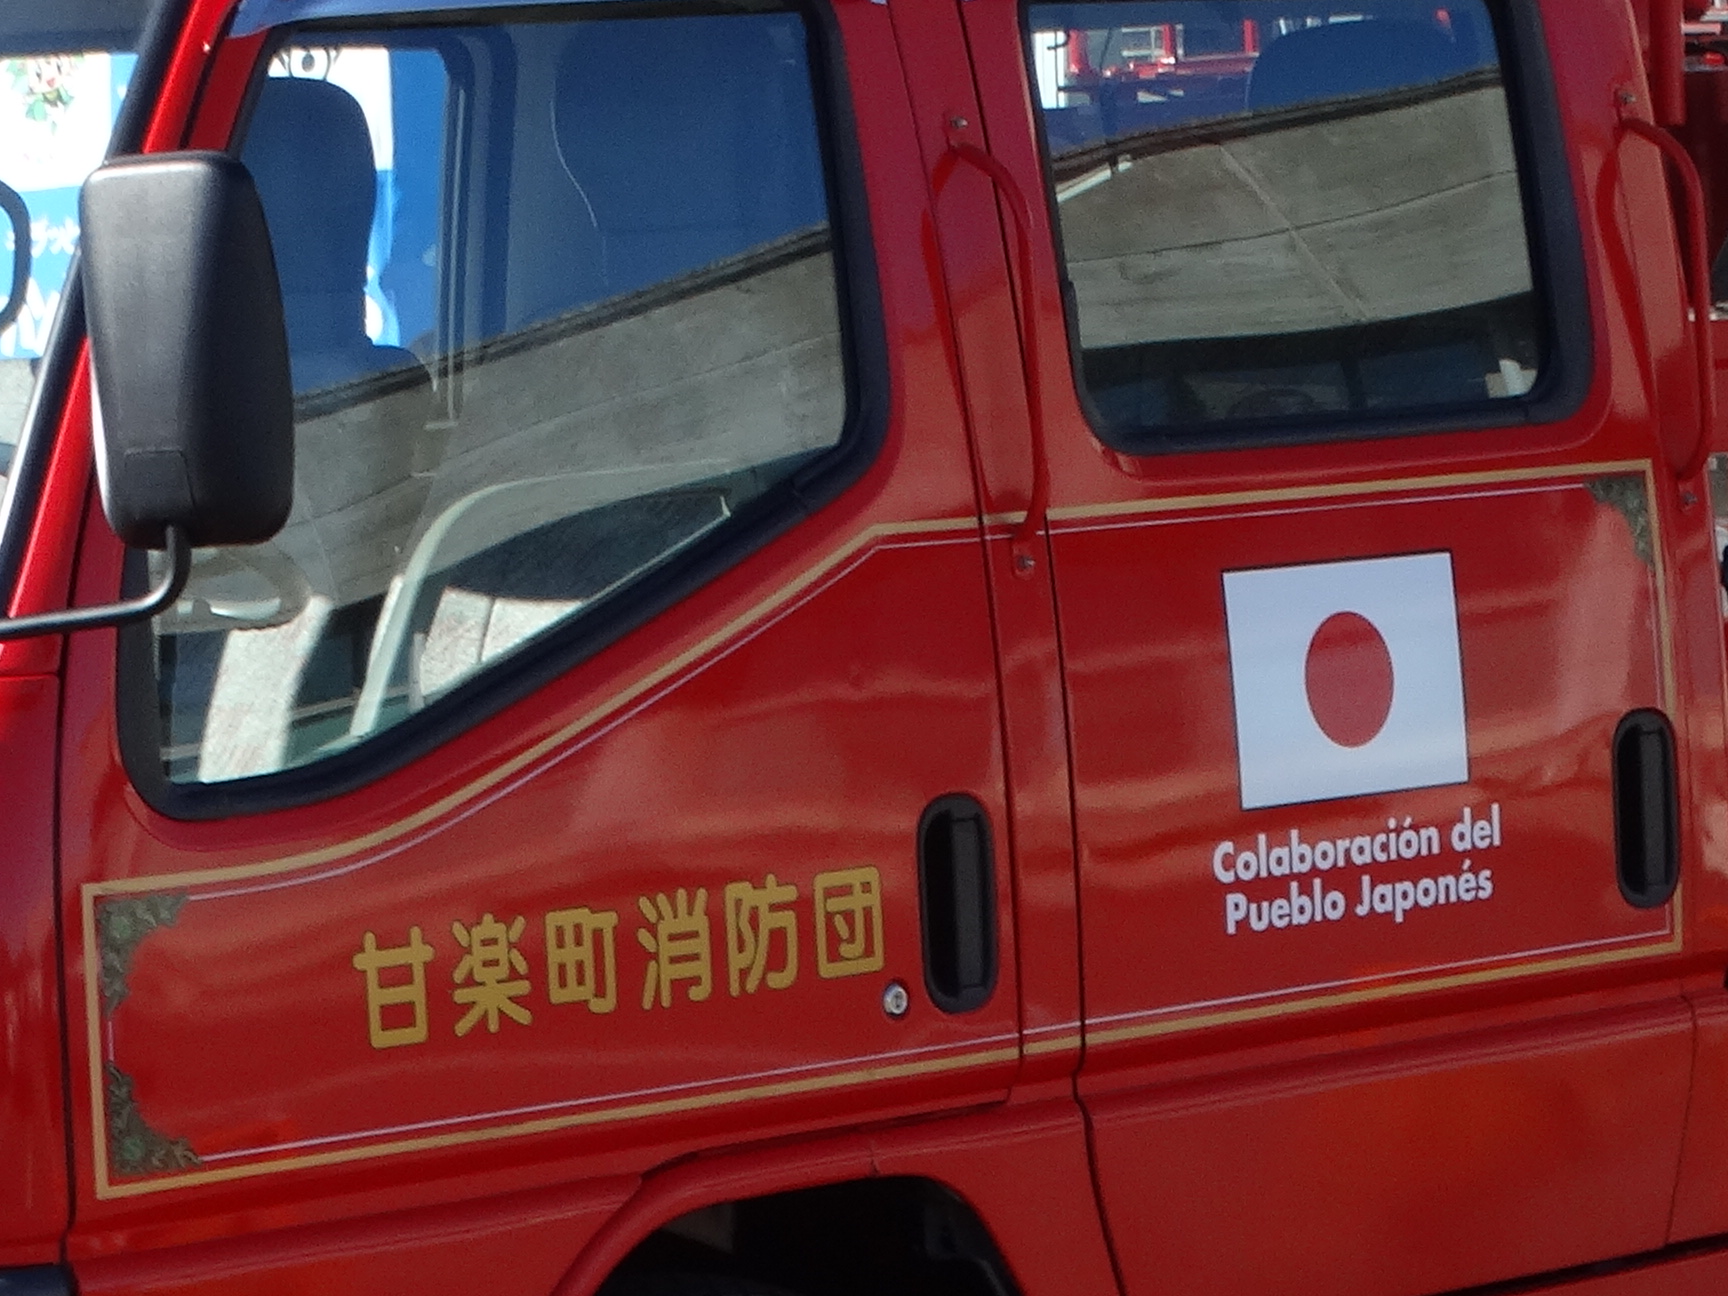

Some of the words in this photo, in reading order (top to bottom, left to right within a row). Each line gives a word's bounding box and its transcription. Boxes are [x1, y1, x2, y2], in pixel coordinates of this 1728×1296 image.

[1212, 817, 1440, 885] Colaboración
[1450, 802, 1502, 853] del
[1224, 878, 1346, 935] Pueblo
[1354, 858, 1494, 924] Japonés
[352, 865, 886, 1050] 甘楽町消防団
